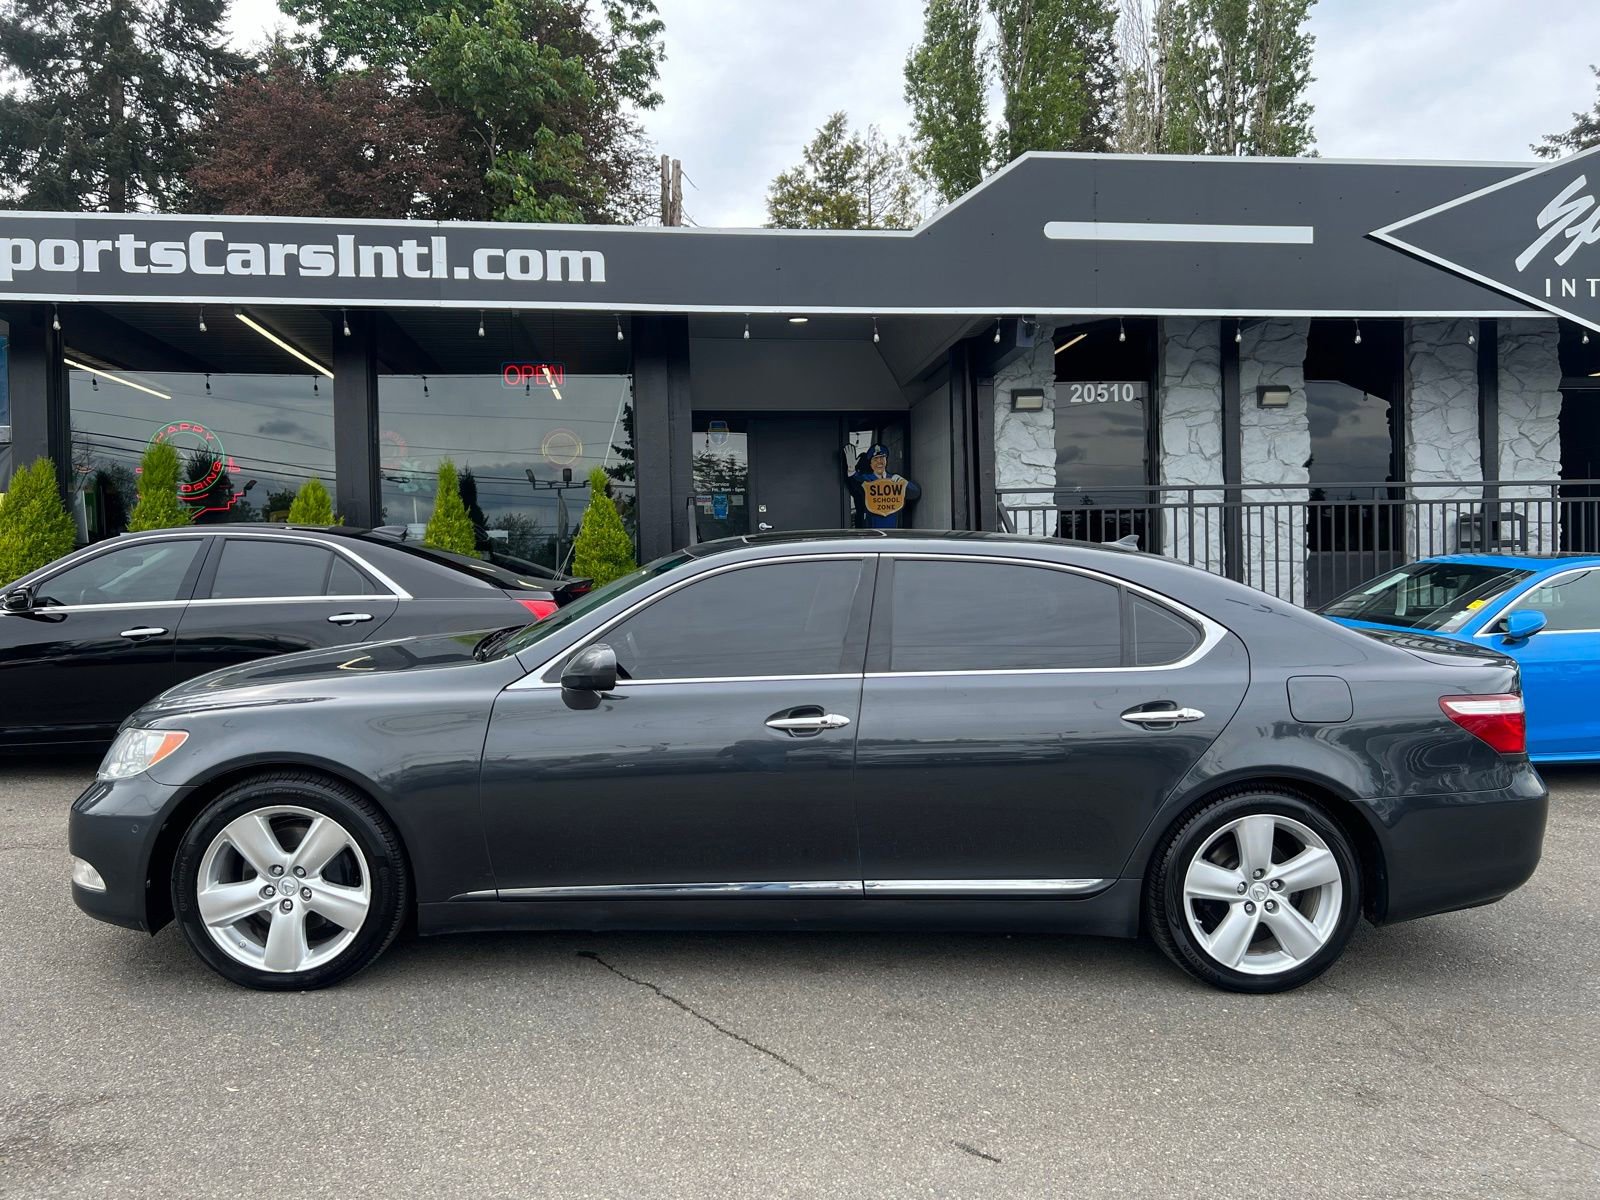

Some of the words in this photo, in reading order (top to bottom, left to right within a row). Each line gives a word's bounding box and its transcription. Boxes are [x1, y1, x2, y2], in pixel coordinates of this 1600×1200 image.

[1545, 278, 1600, 297] INT
[504, 365, 564, 385] OPEN
[1070, 383, 1134, 403] 20510
[870, 484, 903, 496] SLOW
